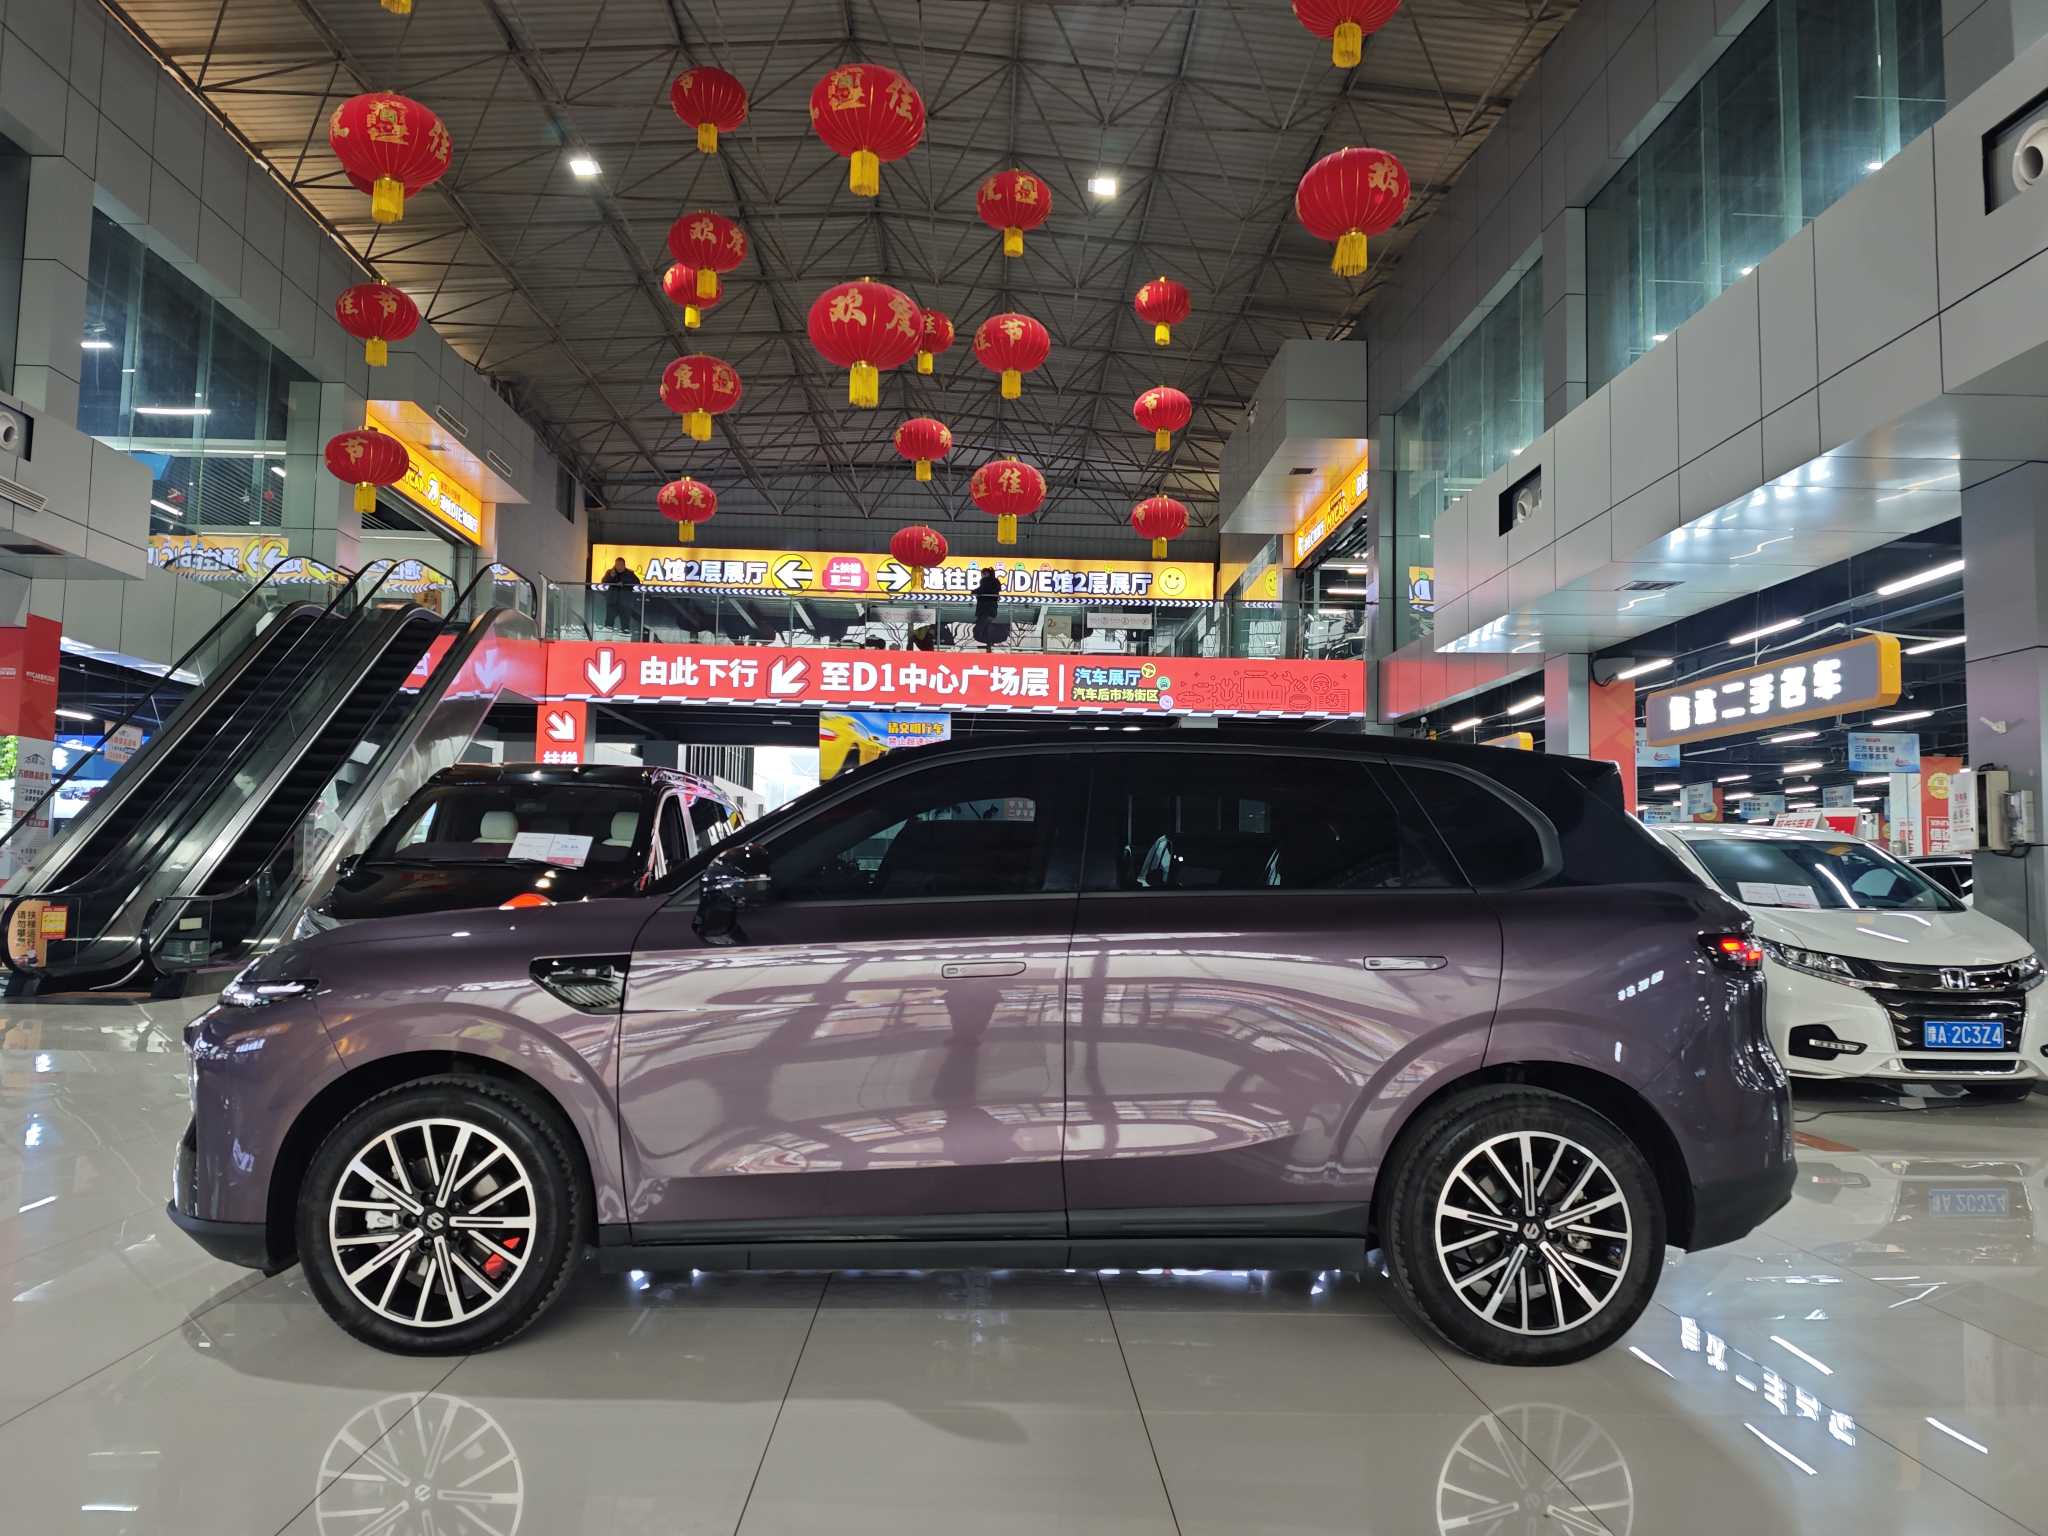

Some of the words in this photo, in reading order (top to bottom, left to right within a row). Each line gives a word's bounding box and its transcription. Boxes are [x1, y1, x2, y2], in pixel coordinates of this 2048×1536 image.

[1368, 155, 1400, 197] 欢
[690, 217, 717, 245] 欢
[829, 288, 867, 327] 欢
[885, 294, 915, 337] 度
[1000, 318, 1026, 347] 节
[673, 363, 700, 390] 度
[998, 468, 1024, 494] 佳
[645, 558, 768, 584] A馆2层展厅
[639, 657, 759, 687] 由此下行
[820, 661, 1050, 698] 至D1中心广场层
[1074, 667, 1142, 687] 汽车展厅
[1072, 687, 1160, 702] 汽车后市场街区
